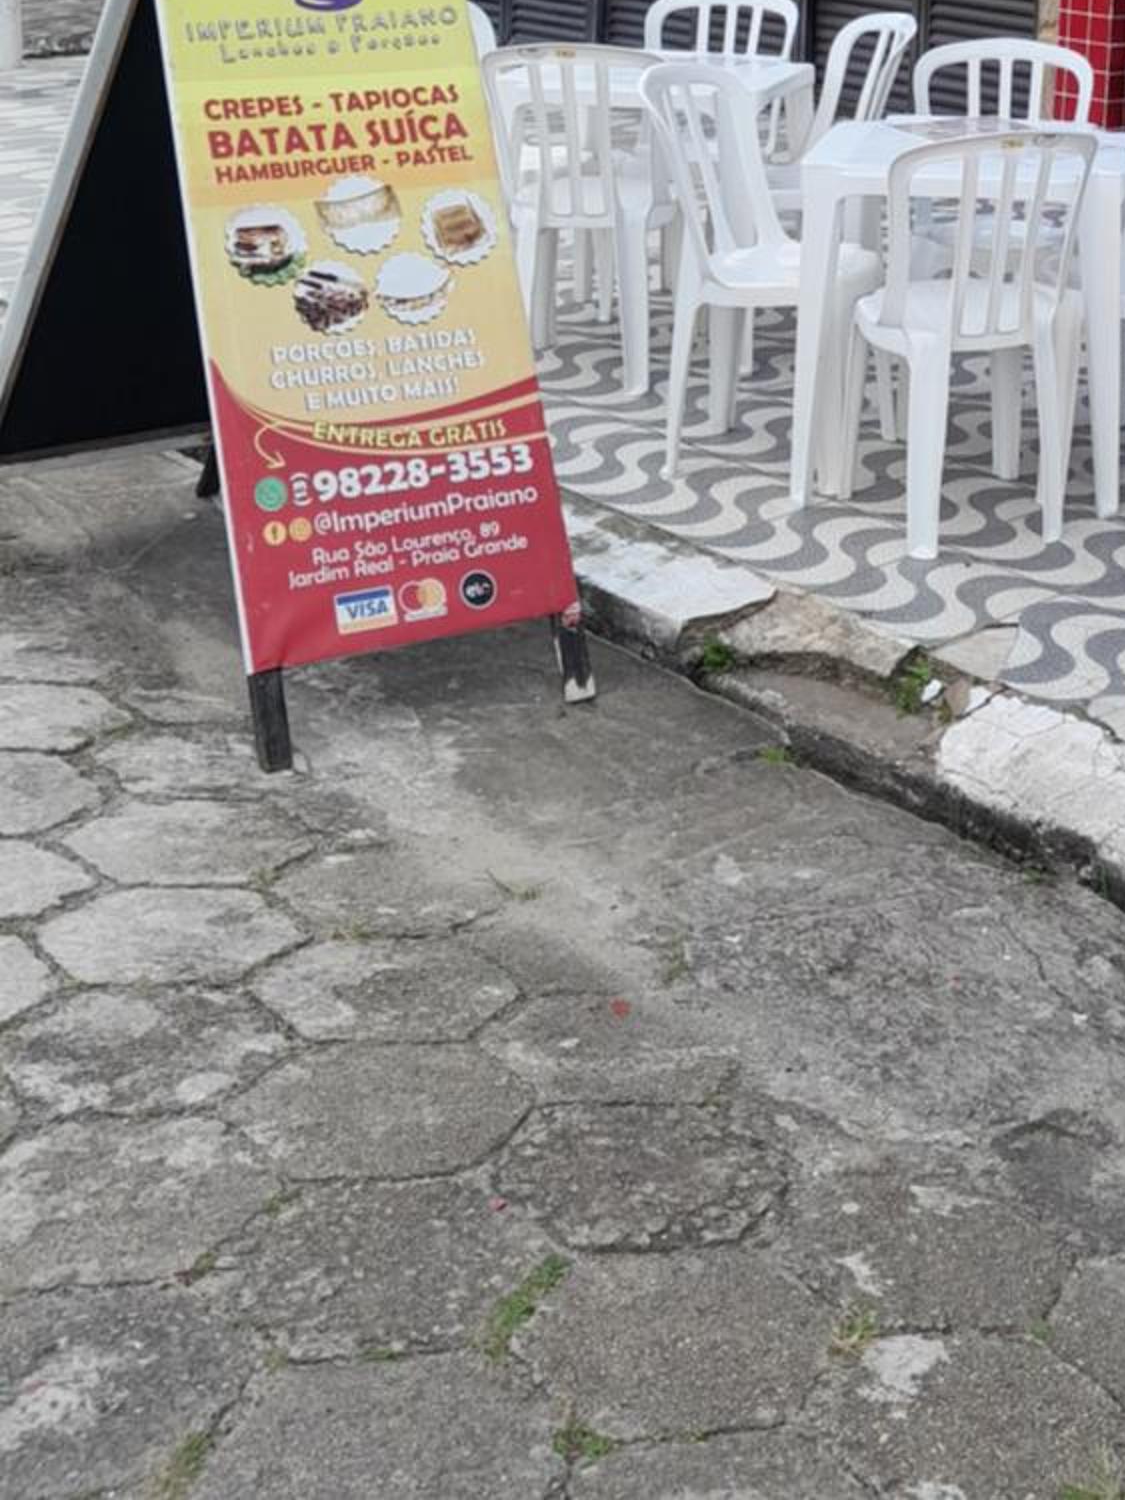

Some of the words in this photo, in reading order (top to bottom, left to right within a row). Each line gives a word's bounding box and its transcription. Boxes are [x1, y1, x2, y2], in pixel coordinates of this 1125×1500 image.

[185, 16, 326, 43] IMPERIUM
[336, 5, 458, 33] PRAIANO
[204, 96, 304, 121] CREPES
[329, 84, 459, 113] TAPIOCAS
[207, 123, 357, 159] BATATA
[365, 110, 468, 150] SUÍÇA
[215, 153, 377, 185] HAMBURGUER
[396, 145, 473, 168] PASTEL
[305, 392, 321, 411] E
[326, 384, 397, 409] MUITO
[313, 420, 423, 447] ENTREGA
[313, 443, 534, 502] 98228-3553
[314, 486, 538, 535] @ImperiumPraiano
[288, 566, 349, 590] Jardim
[354, 556, 394, 577] Real
[411, 546, 461, 567] Praia
[464, 533, 528, 557] Grande
[312, 546, 349, 565] Rua
[355, 540, 387, 561] São
[480, 521, 500, 538] 89
[346, 600, 388, 619] VISA
